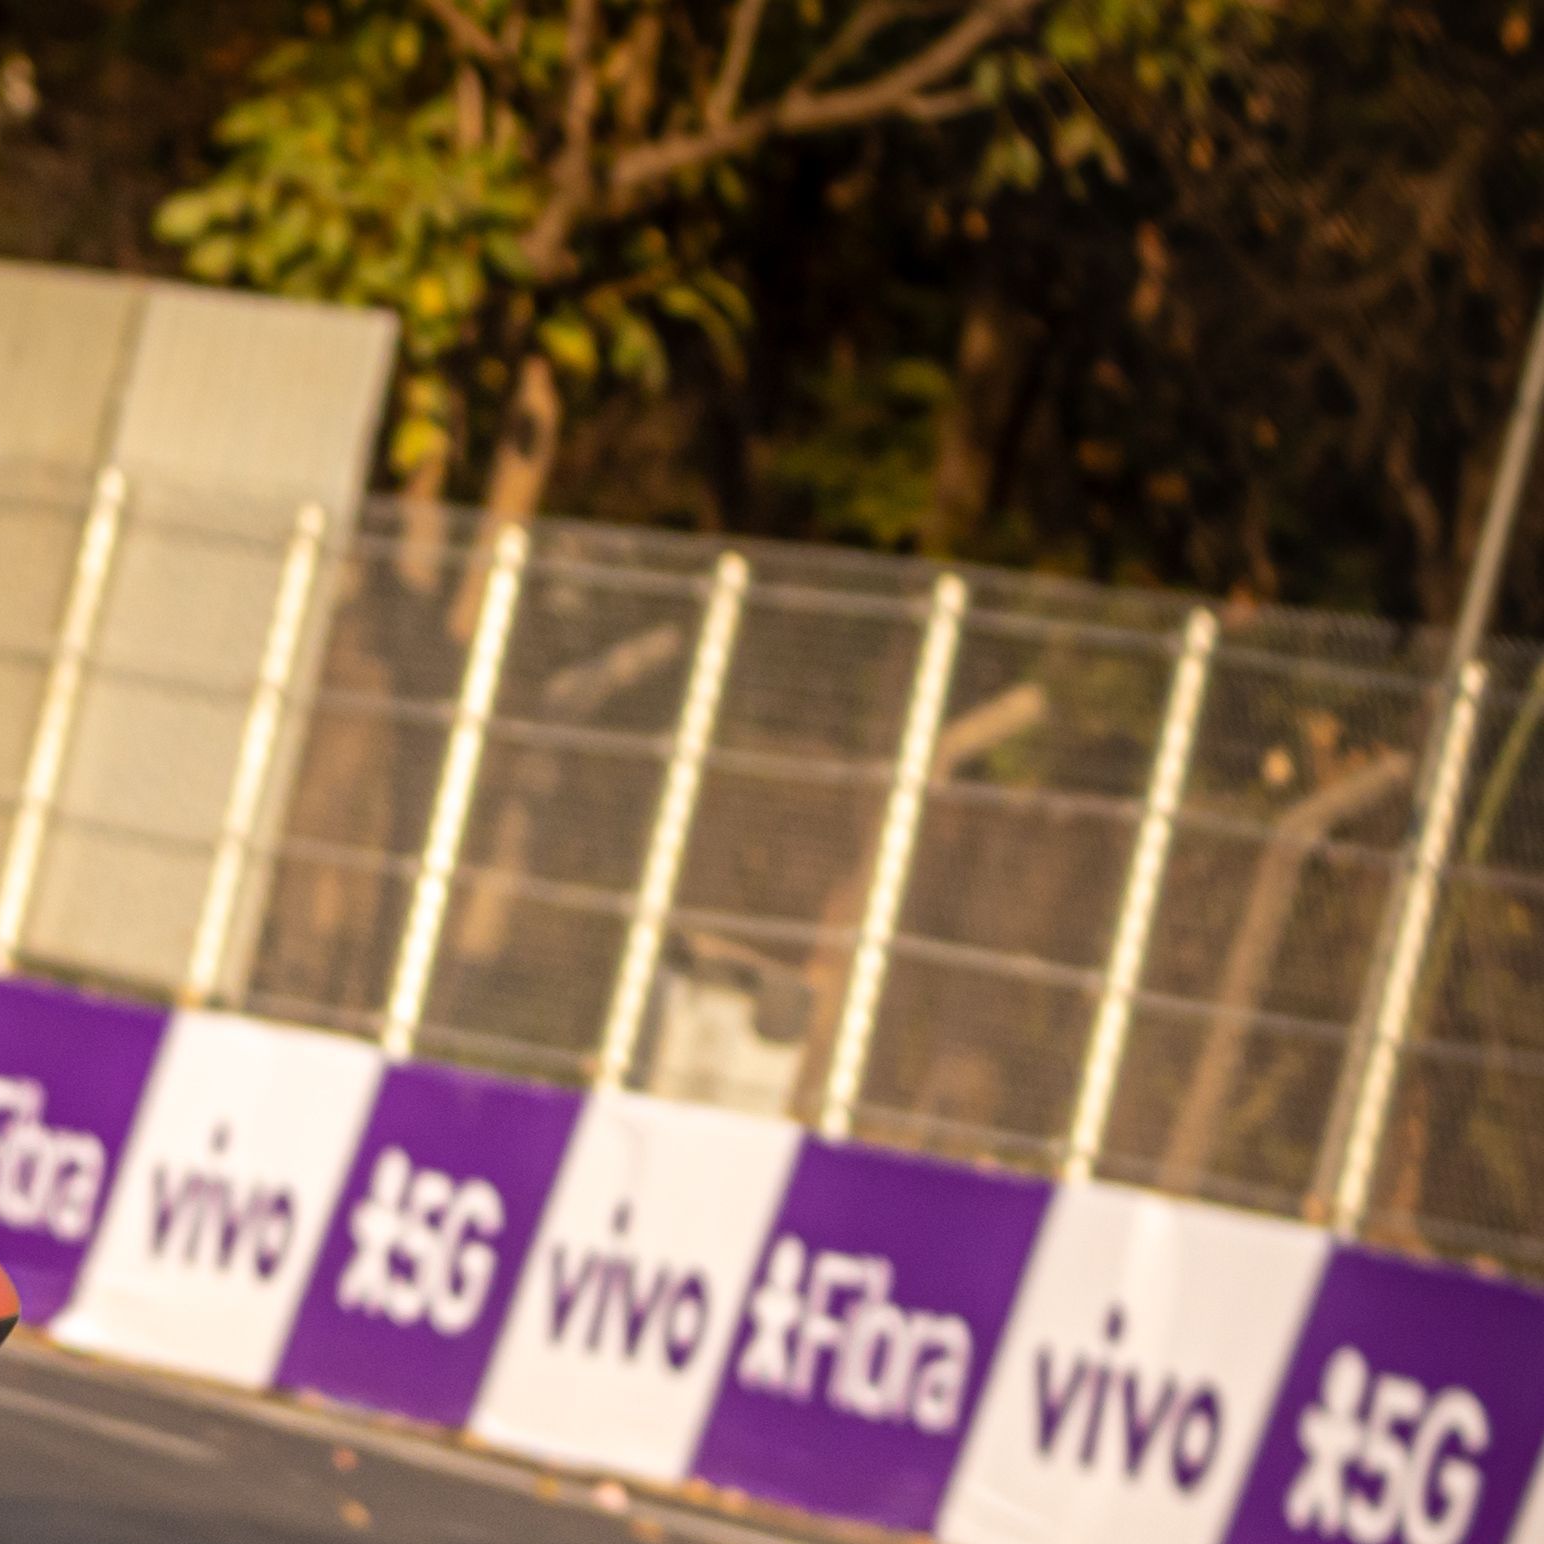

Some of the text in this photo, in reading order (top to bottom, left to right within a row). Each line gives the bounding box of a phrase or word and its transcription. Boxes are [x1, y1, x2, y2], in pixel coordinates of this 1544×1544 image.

[146, 1119, 301, 1284] vivo
[392, 1162, 508, 1336] 5G
[546, 1201, 714, 1374] vivo
[1030, 1302, 1228, 1495] vivo
